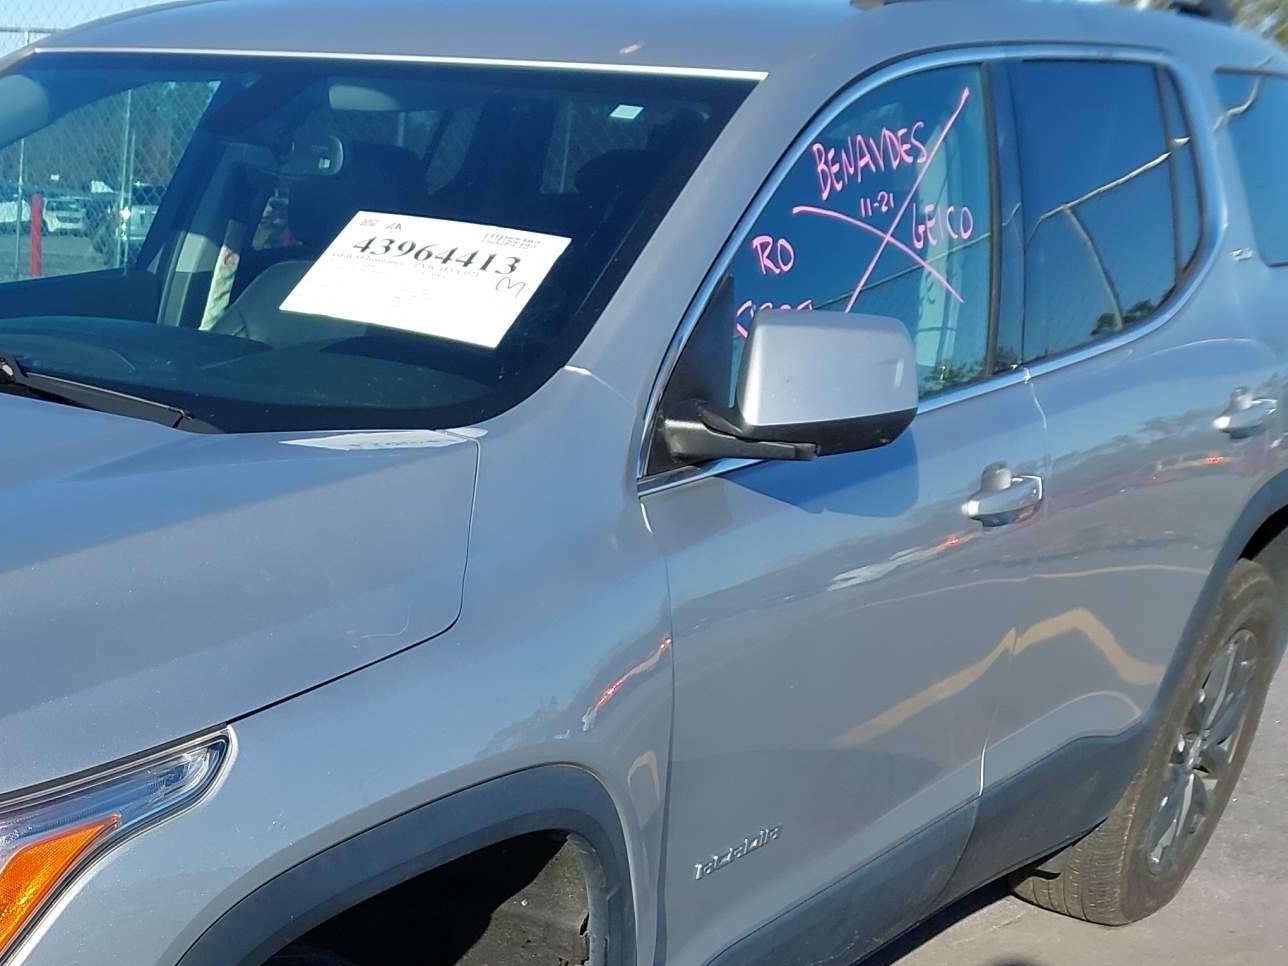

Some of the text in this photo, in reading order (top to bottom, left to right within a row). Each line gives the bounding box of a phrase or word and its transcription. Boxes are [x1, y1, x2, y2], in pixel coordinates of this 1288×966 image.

[860, 191, 894, 217] 11-21
[913, 203, 974, 249] GEICO
[353, 236, 521, 276] 43964413
[752, 235, 795, 275] RO
